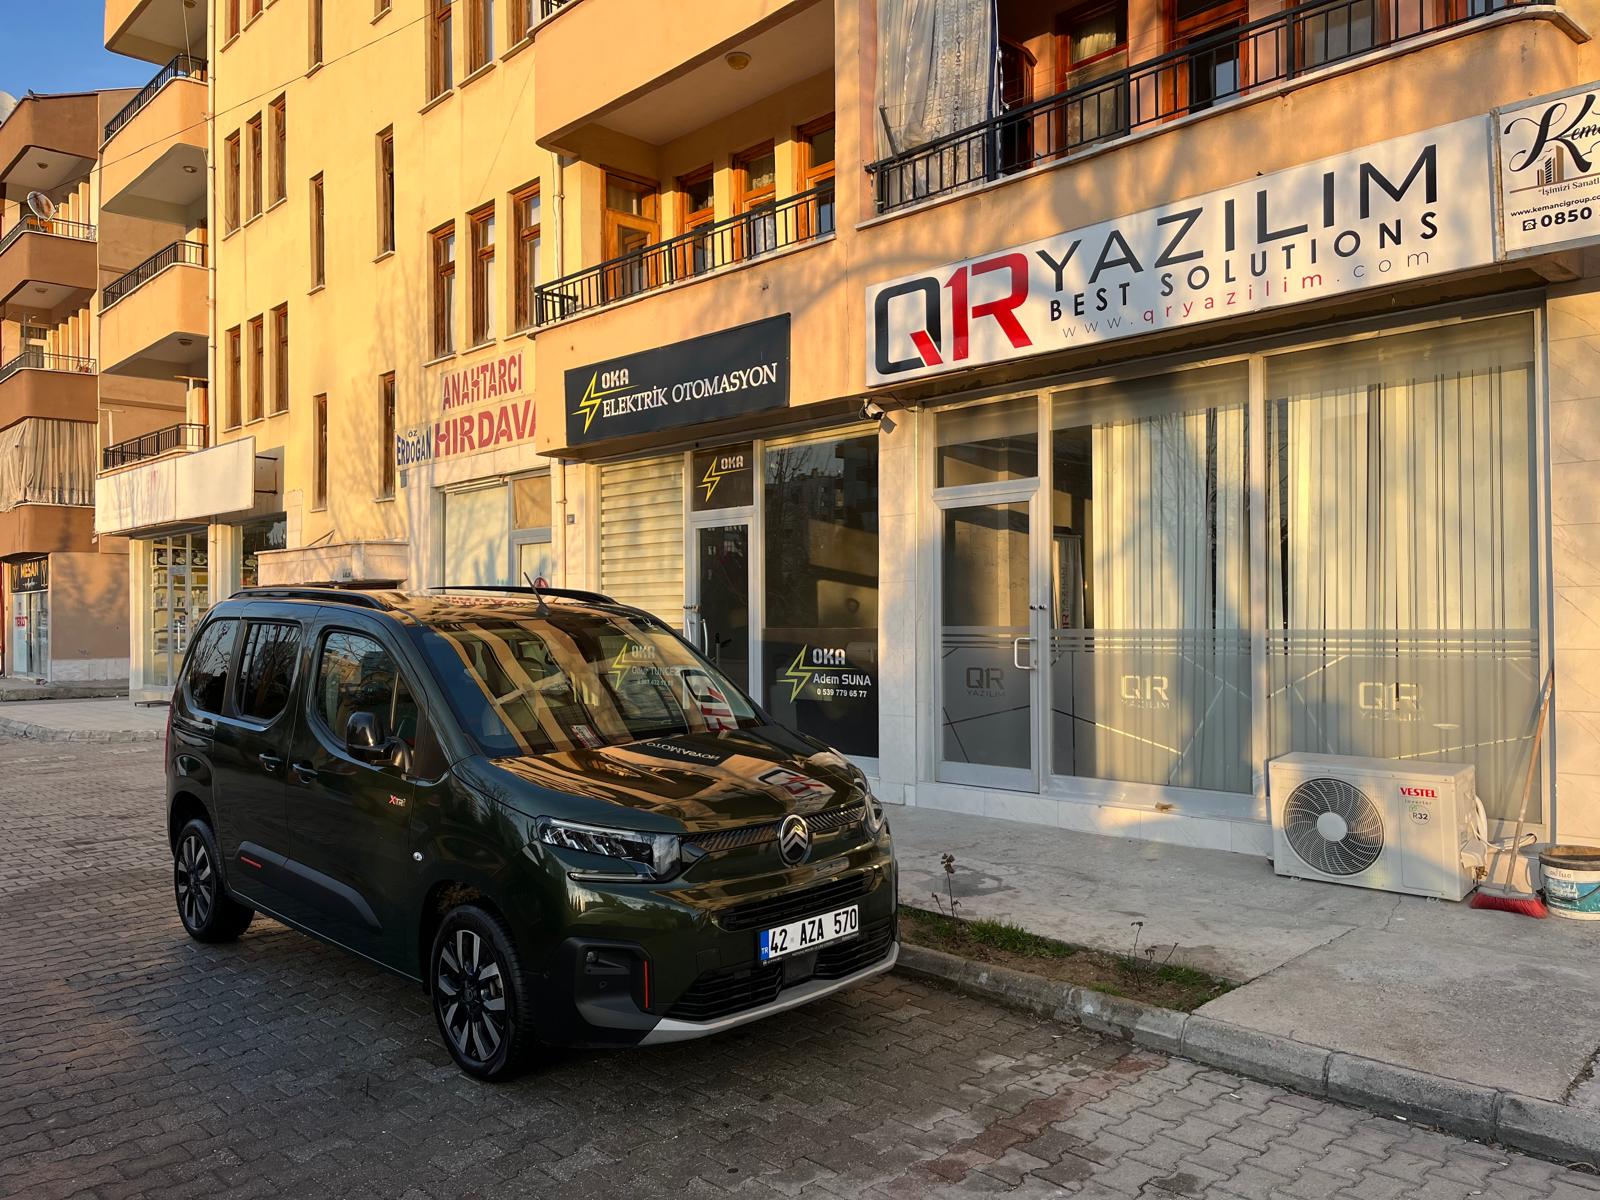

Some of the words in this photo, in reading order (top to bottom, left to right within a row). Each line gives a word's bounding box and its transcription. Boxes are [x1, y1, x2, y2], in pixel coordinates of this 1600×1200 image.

[1036, 143, 1437, 291] YAZILIM
[1540, 206, 1592, 228] 0850
[1050, 282, 1130, 322] BEST
[1160, 211, 1438, 297] SOLUTIONS
[1062, 250, 1429, 339] www.qryazilim.com
[442, 353, 522, 411] ANAHTARCI
[601, 368, 629, 389] OKA
[602, 385, 668, 418] ELEKTRİK
[672, 362, 778, 403] OTOMASYON
[396, 426, 432, 466] ERDOĞAN
[720, 455, 744, 470] OKA
[812, 648, 846, 665] OKA
[812, 673, 840, 685] Adem
[841, 674, 872, 686] SUNA
[816, 688, 821, 696] 0
[822, 688, 834, 696] 539
[849, 689, 857, 697] 65
[858, 690, 867, 698] 77
[1400, 787, 1438, 798] VESTEL
[1412, 812, 1428, 820] R32
[761, 946, 769, 954] TR
[770, 929, 788, 953] 42
[800, 918, 824, 946] AZA
[834, 908, 857, 935] 570
